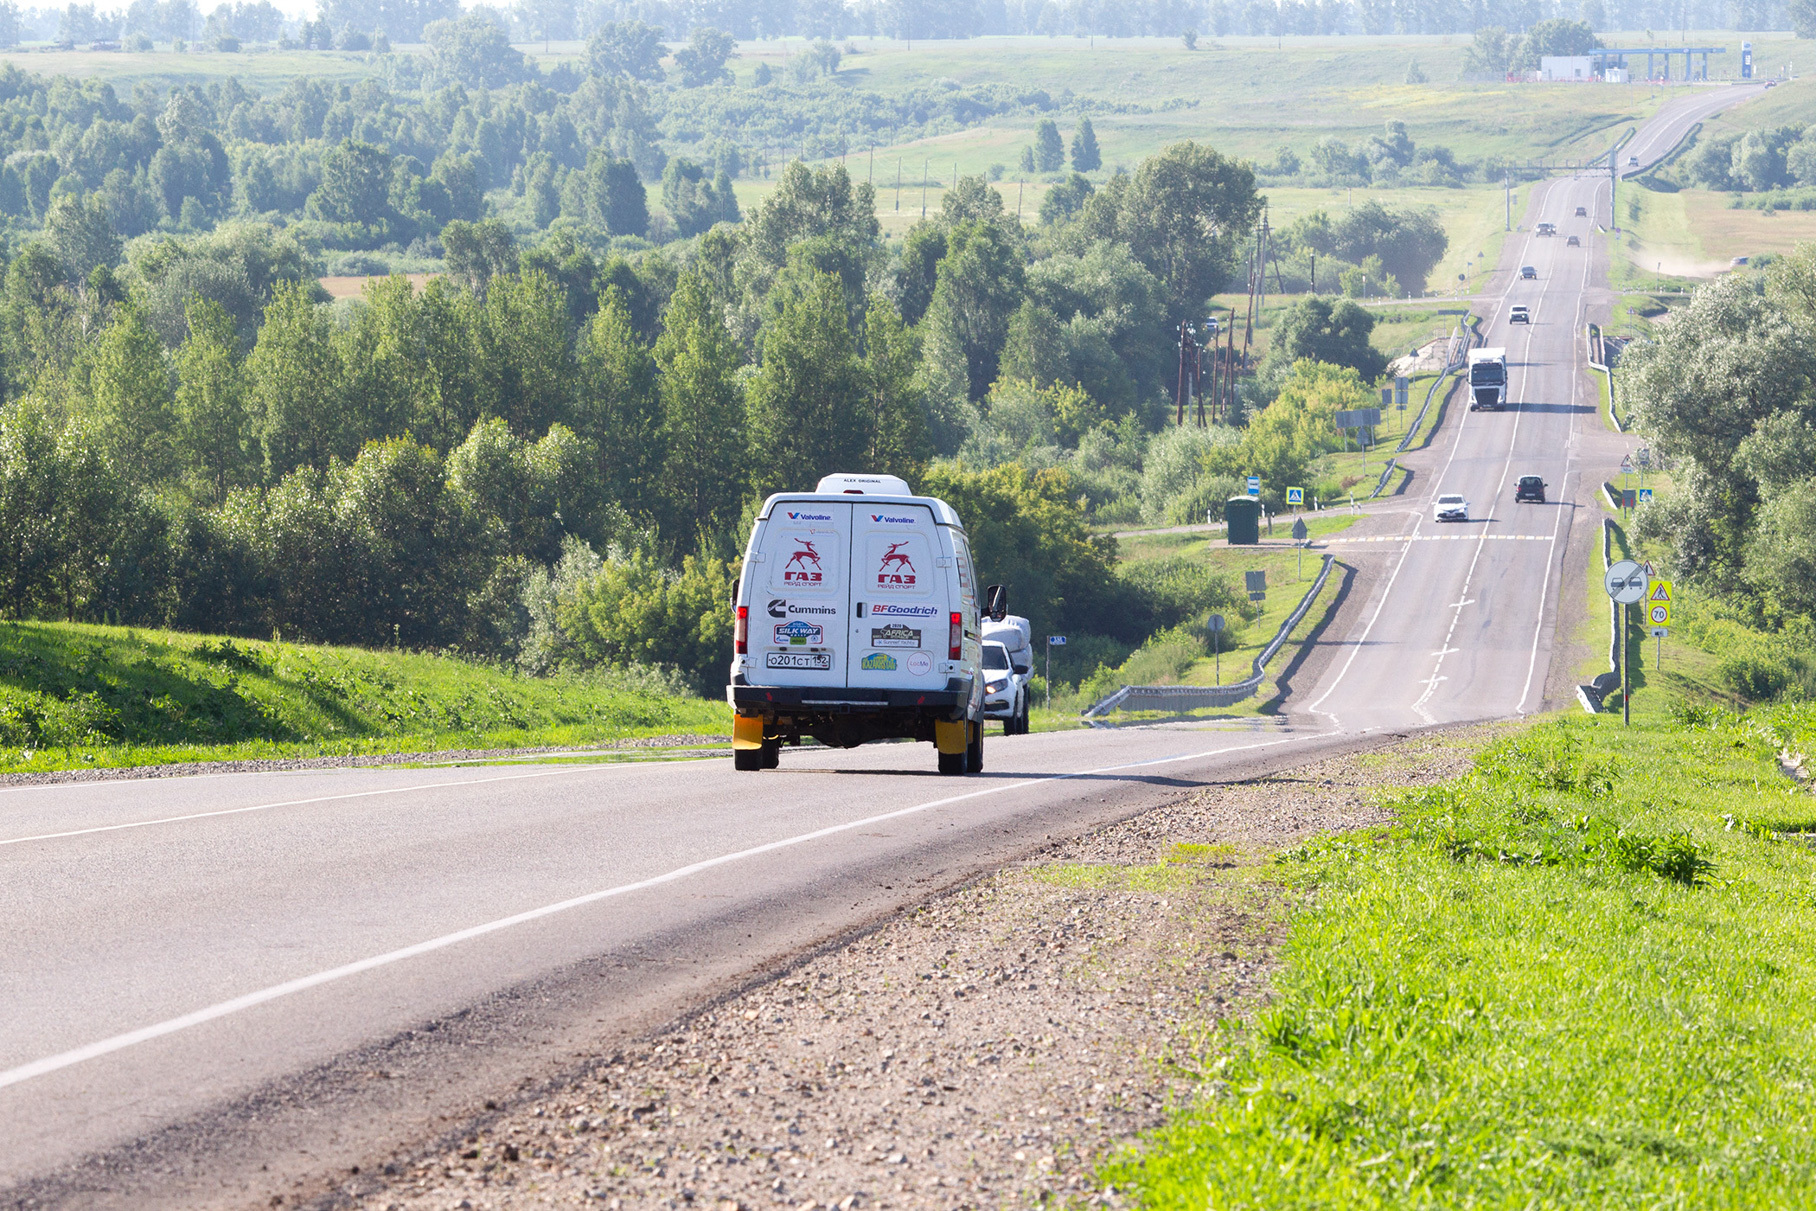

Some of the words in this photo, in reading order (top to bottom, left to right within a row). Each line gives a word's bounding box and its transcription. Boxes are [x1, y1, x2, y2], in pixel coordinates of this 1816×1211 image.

[784, 571, 823, 582] ГАЗ
[878, 574, 916, 584] ГАЗ
[788, 605, 836, 616] Cummins
[872, 605, 938, 616] BFGoodrich
[1654, 611, 1664, 619] 70
